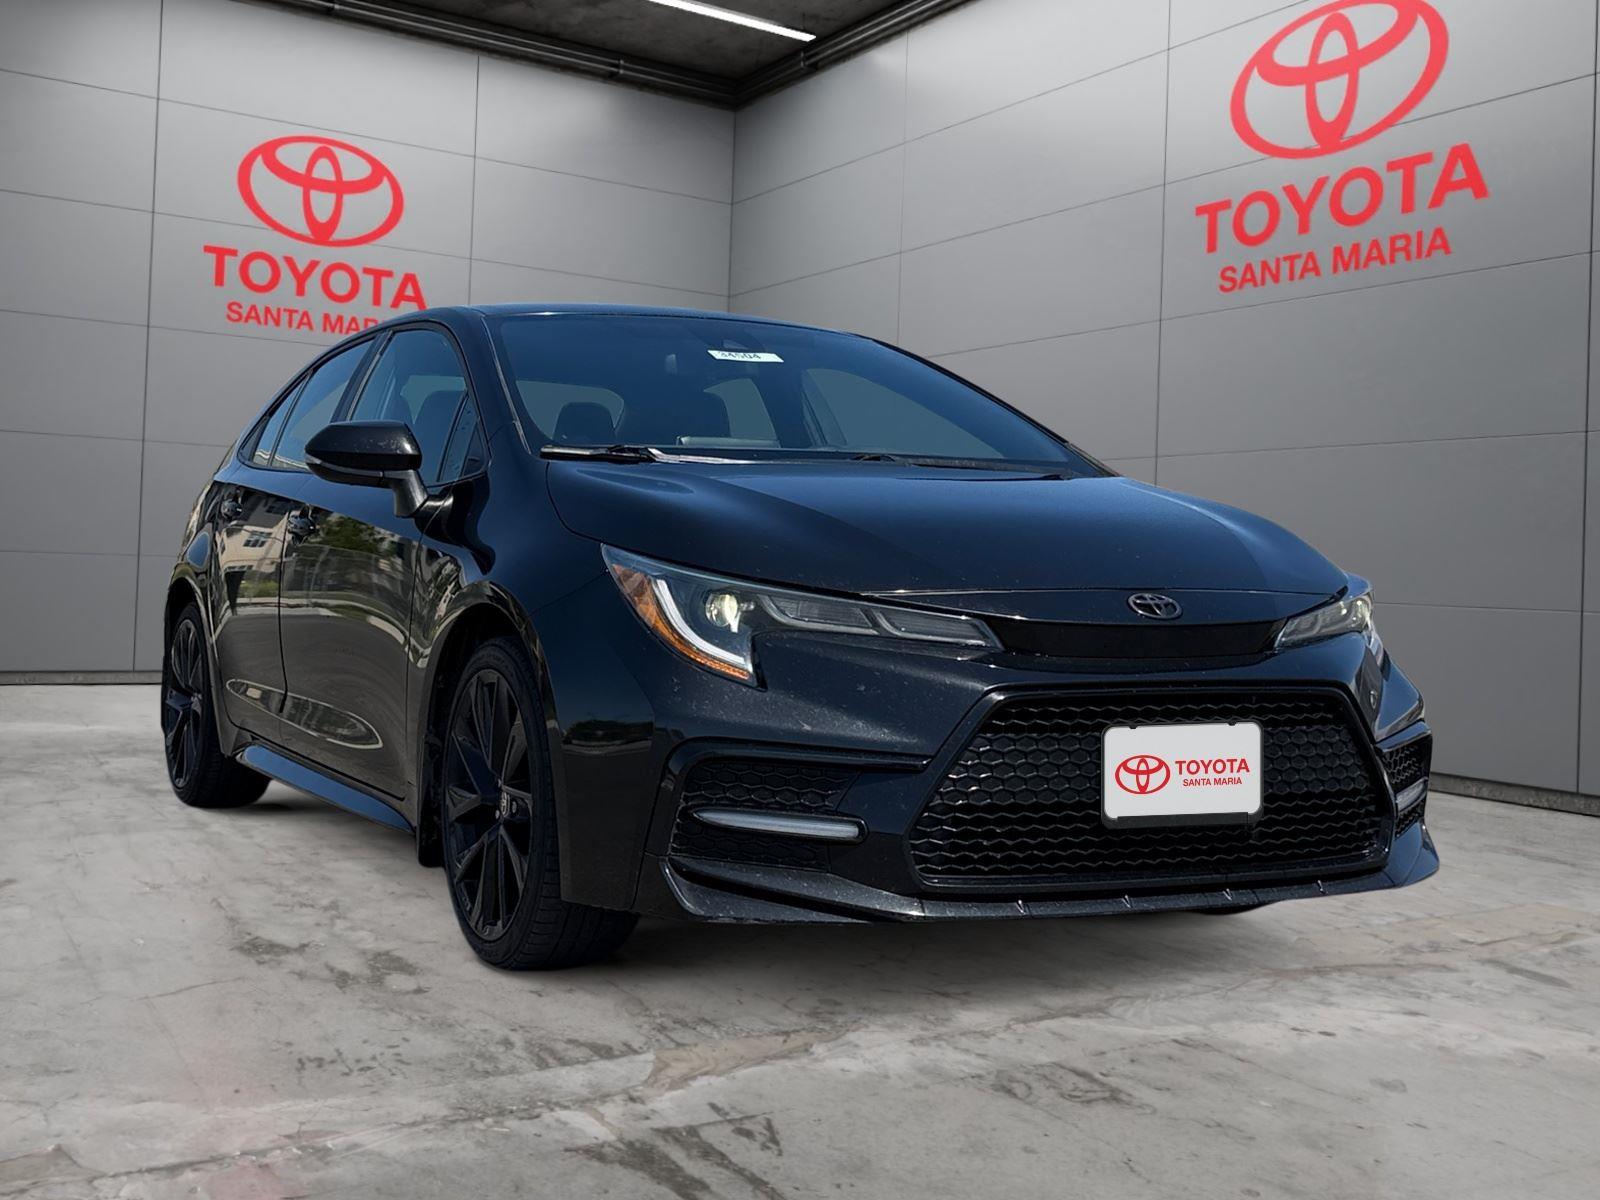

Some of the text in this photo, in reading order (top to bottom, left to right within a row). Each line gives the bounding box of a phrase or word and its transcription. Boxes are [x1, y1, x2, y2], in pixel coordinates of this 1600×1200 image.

[1194, 142, 1490, 254] TOYOTA
[203, 244, 428, 311] TOYOTA
[1218, 226, 1453, 294] SANTA MARIA
[226, 301, 385, 335] SANTA MAR
[1175, 758, 1250, 775] TOYOTA
[1182, 777, 1243, 787] SANTA MARIA
